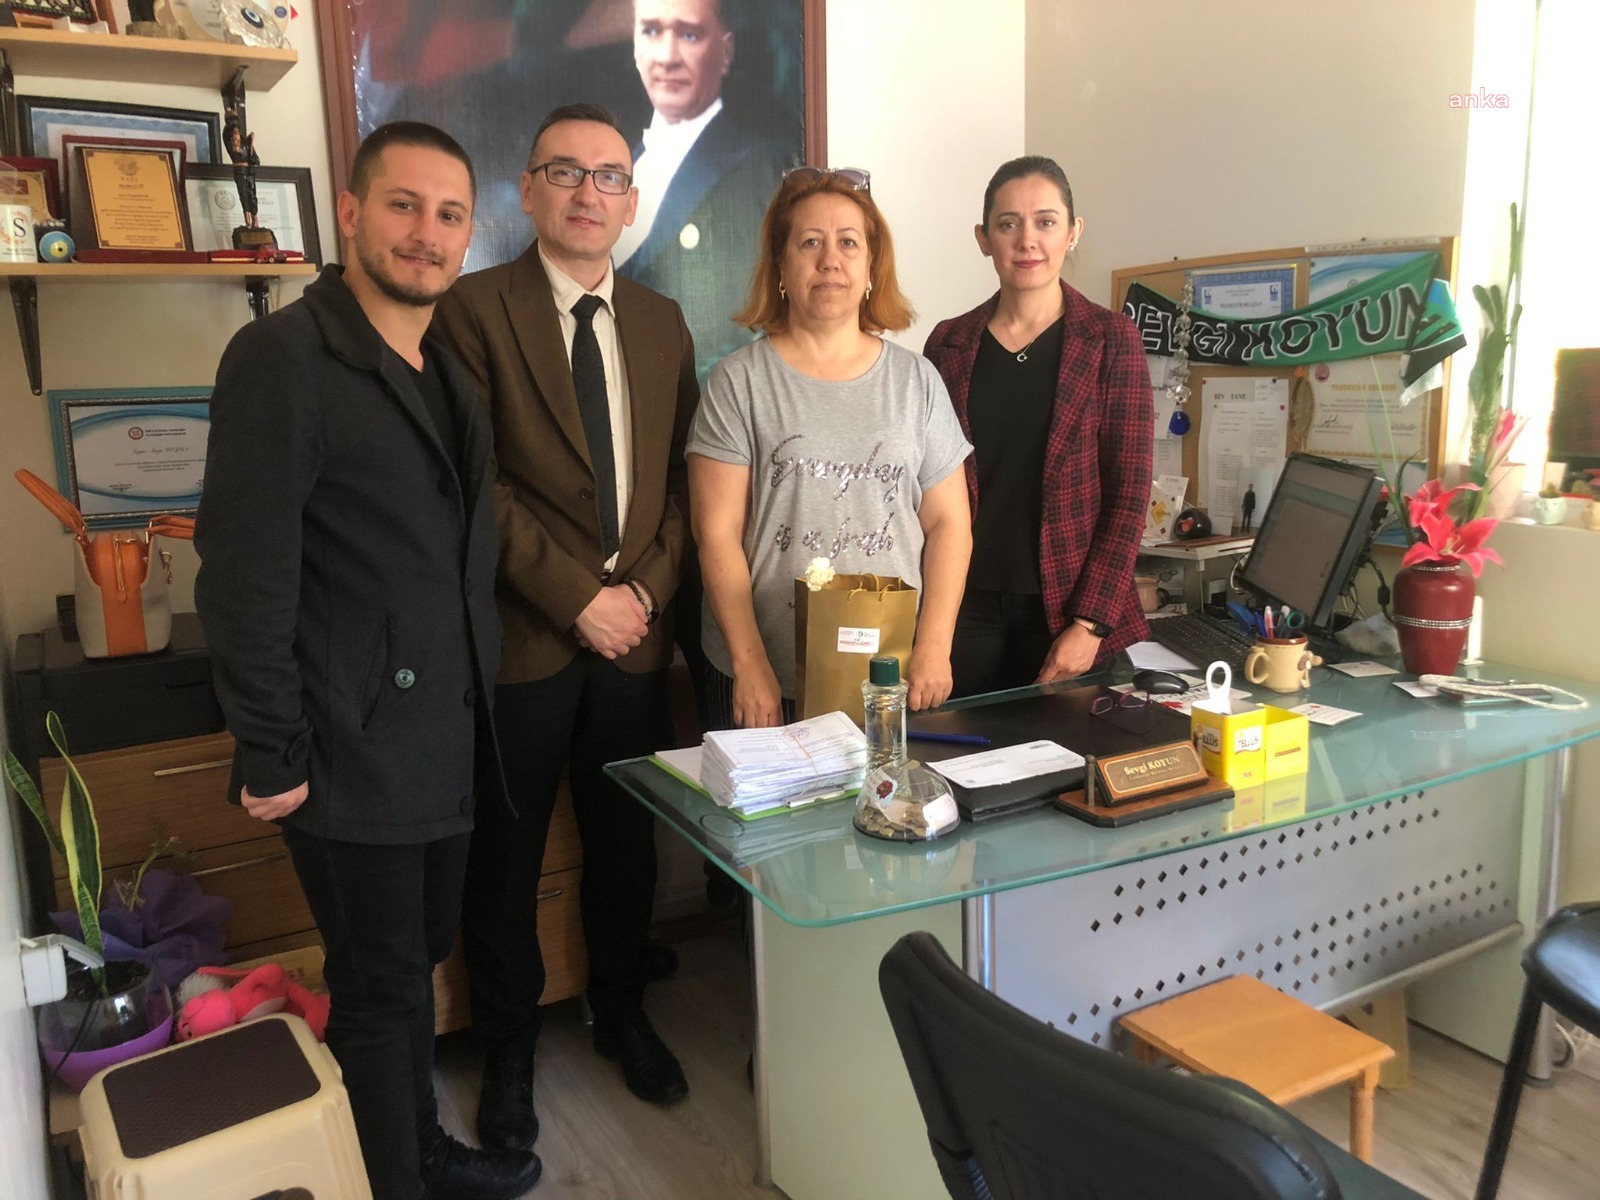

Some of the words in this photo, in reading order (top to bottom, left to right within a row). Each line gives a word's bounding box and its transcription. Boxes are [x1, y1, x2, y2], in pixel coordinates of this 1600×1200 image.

[13, 217, 27, 238] S
[1123, 761, 1148, 776] Sevgi
[1147, 755, 1181, 771] KOYUN
